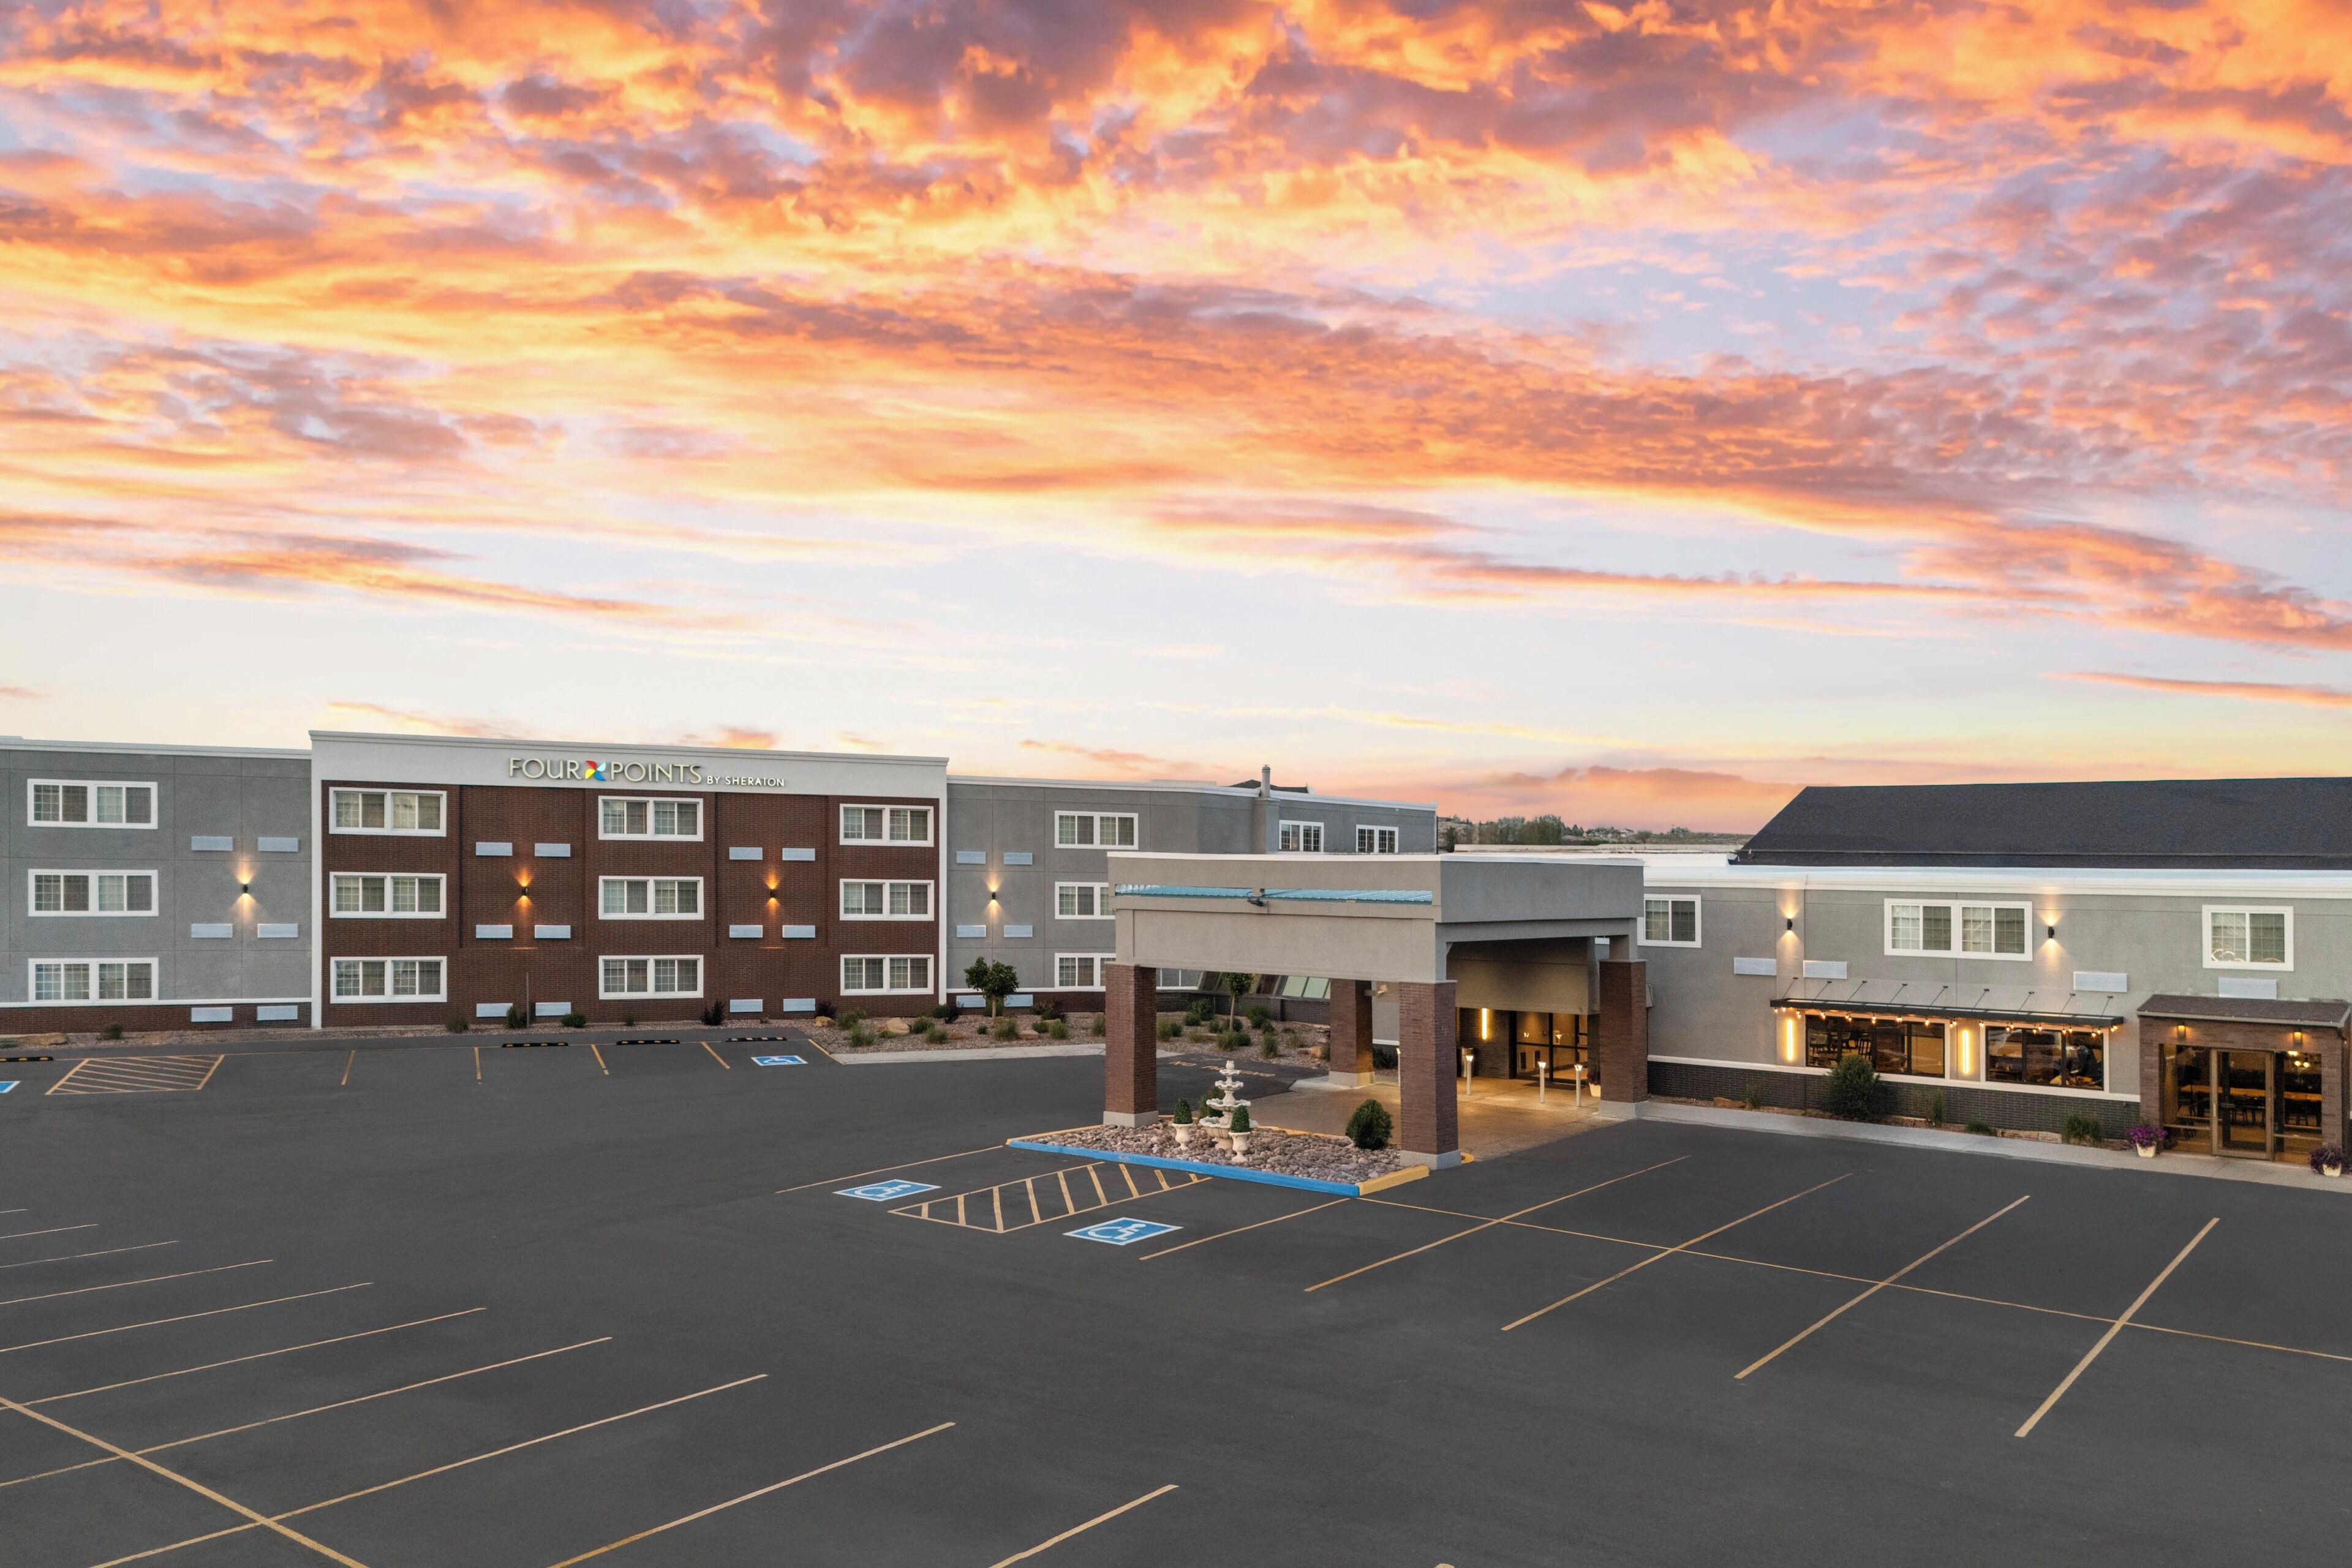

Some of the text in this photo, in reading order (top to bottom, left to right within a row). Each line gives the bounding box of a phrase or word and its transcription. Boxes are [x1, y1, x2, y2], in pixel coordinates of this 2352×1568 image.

[510, 758, 785, 787] FOUR POINTS BY SHERATON
